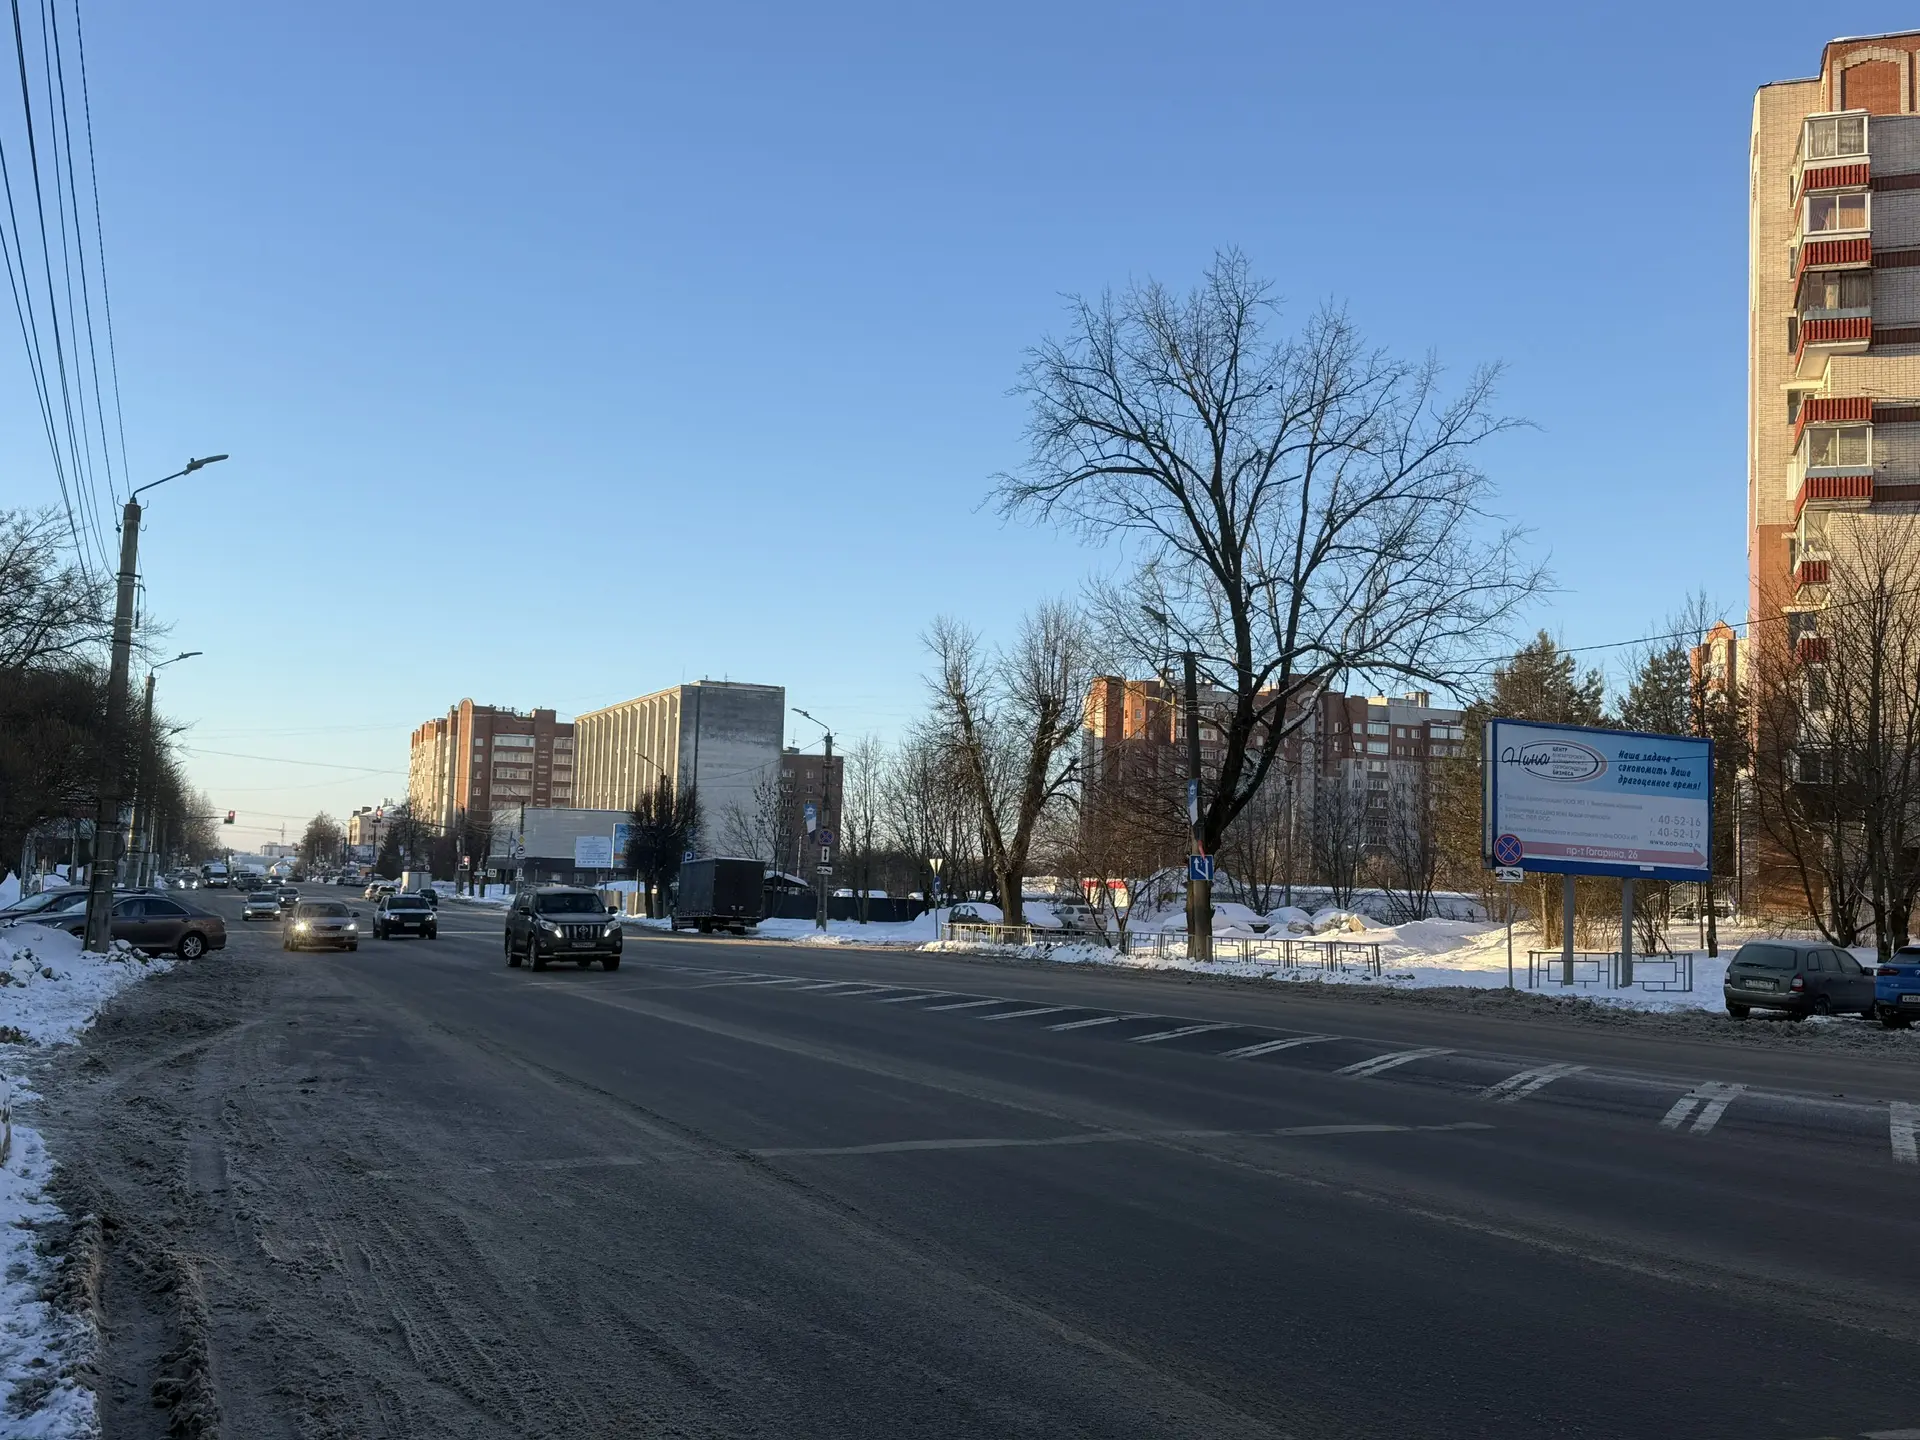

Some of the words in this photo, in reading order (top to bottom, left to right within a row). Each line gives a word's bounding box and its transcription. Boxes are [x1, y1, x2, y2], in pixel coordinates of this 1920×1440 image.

[1502, 747, 1550, 766] Нина
[1618, 749, 1640, 760] Наша
[1643, 751, 1672, 763] задача
[1618, 763, 1668, 775] сэкономить
[1670, 766, 1692, 778] Ваше
[1618, 774, 1671, 788] драгоценное
[1673, 782, 1701, 790] время!
[1658, 815, 1701, 827] 40-52-16
[1657, 827, 1701, 839] 40-52-17
[1566, 847, 1585, 857] пр-т
[1585, 847, 1627, 859] Гагарина,
[1628, 850, 1639, 859] 26
